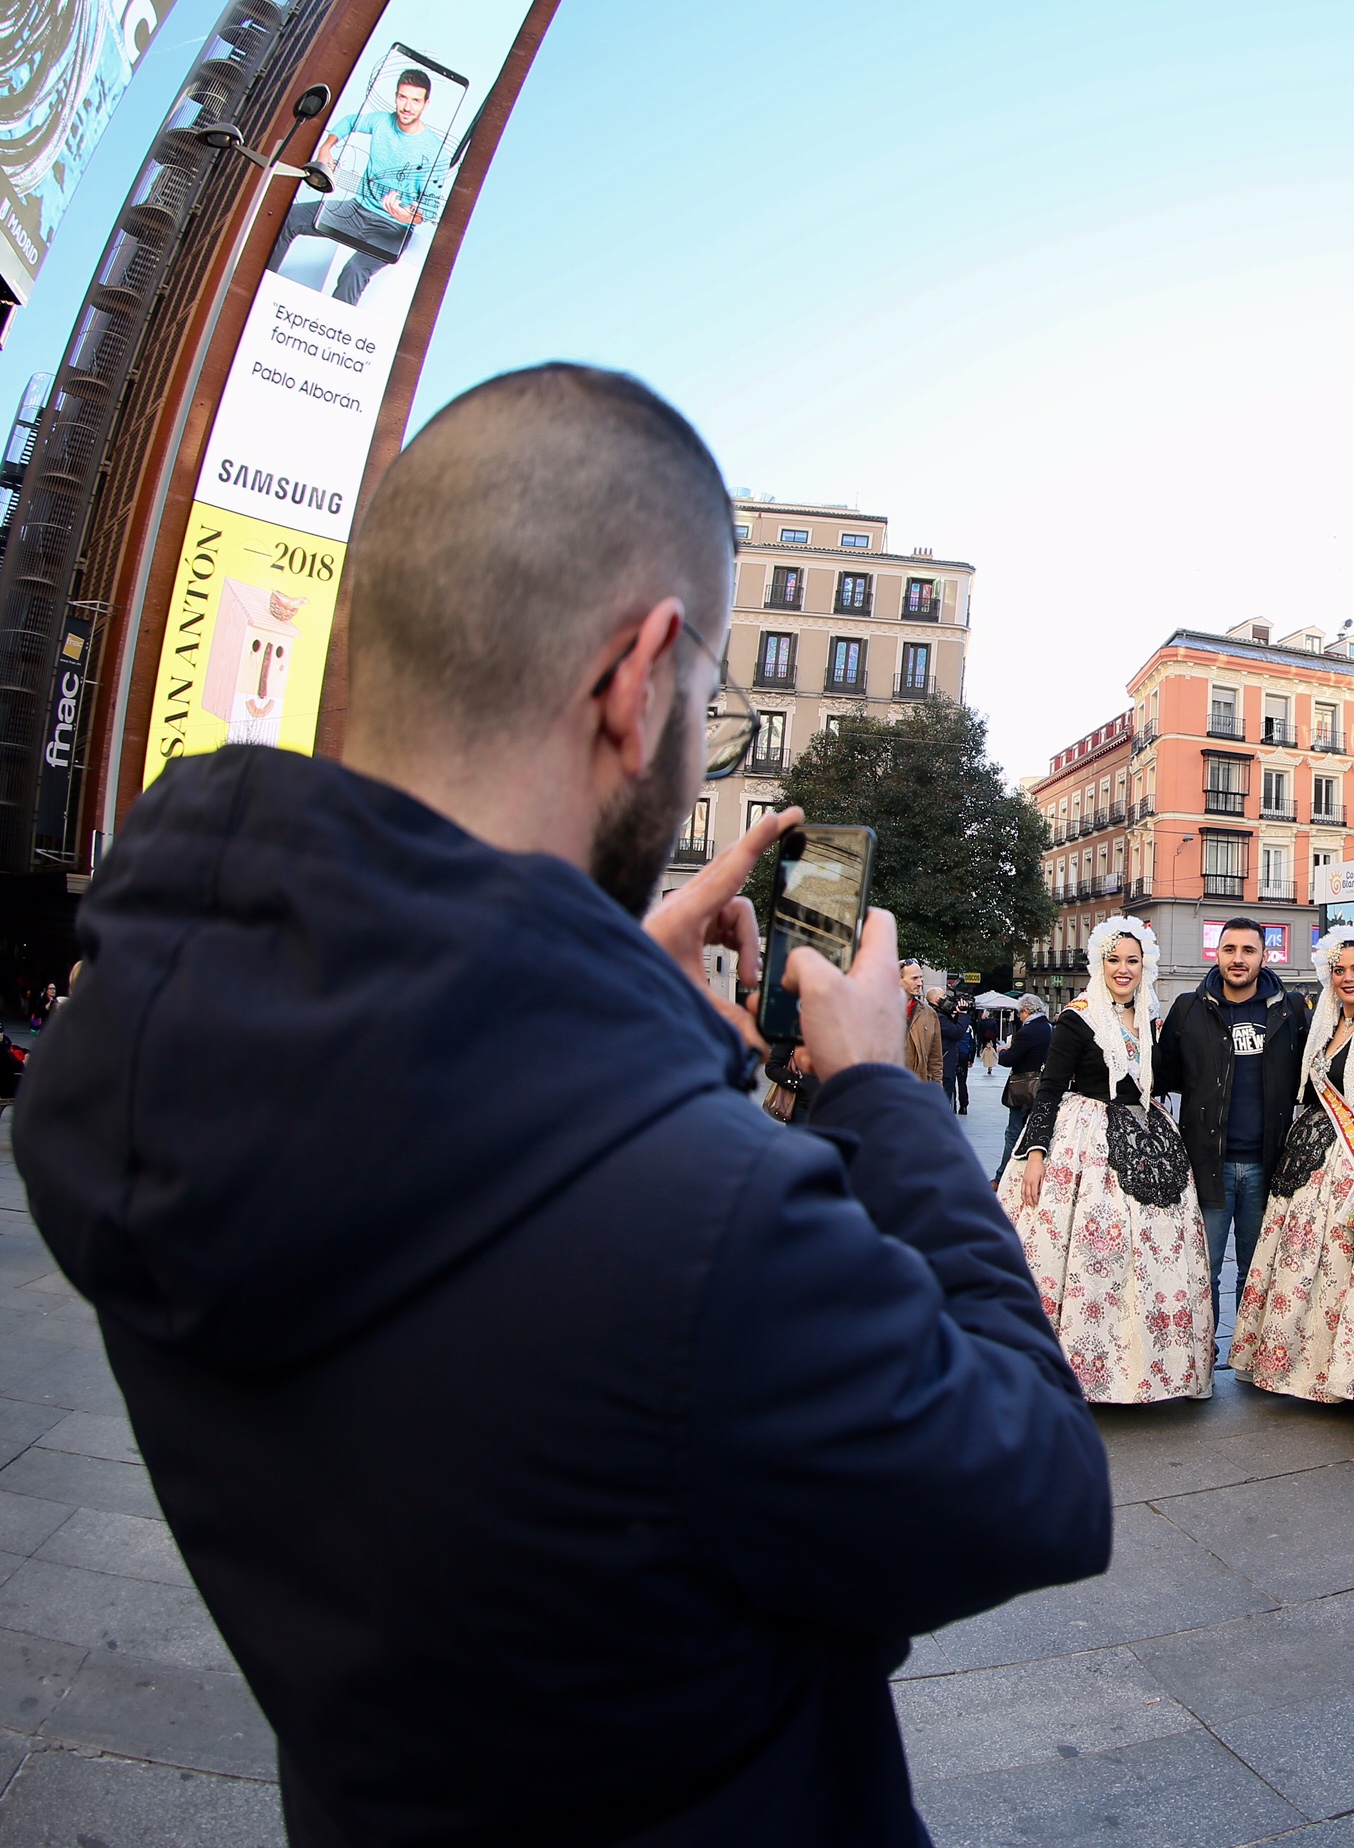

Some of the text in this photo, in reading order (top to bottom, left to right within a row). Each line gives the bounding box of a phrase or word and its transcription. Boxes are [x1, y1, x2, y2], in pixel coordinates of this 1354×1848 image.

[8, 213, 39, 265] MADRID
[271, 326, 318, 357] forma
[355, 338, 376, 354] de
[252, 361, 363, 413] Pablo Alborán.
[218, 459, 343, 514] SAMSUNG
[160, 524, 223, 758] SAN ANTÓN
[45, 671, 80, 768] fnac
[1233, 1036, 1254, 1050] THE
